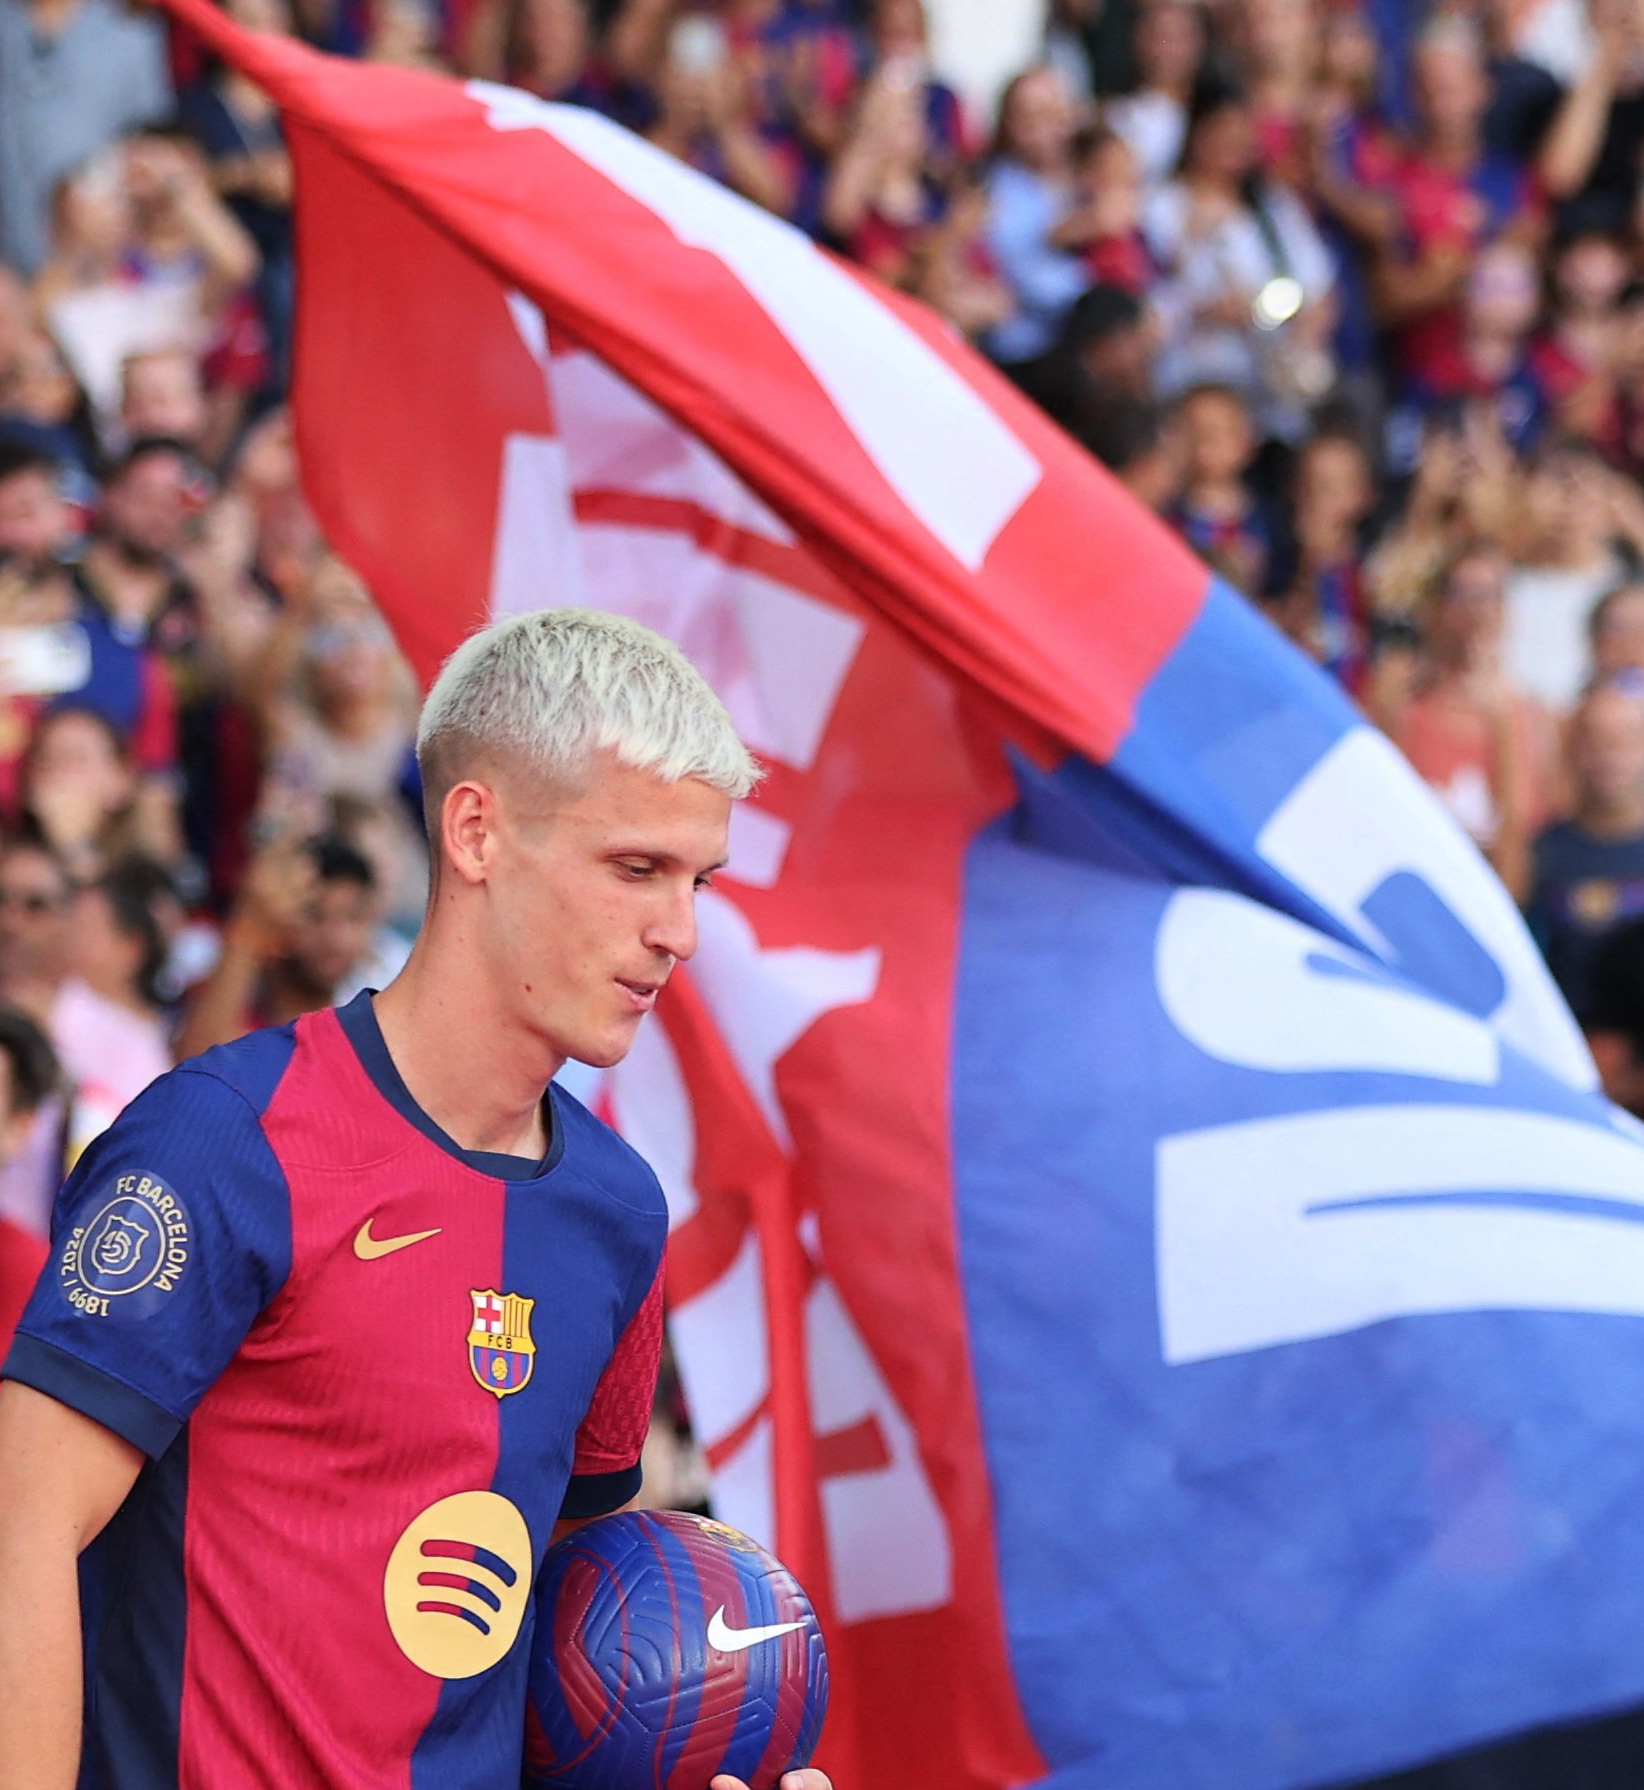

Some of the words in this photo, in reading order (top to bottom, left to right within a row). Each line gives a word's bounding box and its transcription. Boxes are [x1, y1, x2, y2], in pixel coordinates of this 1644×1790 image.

[61, 1227, 85, 1276] 2024
[116, 1175, 137, 1195] FC
[136, 1177, 188, 1292] BARCELONA
[68, 1287, 110, 1317] 1899
